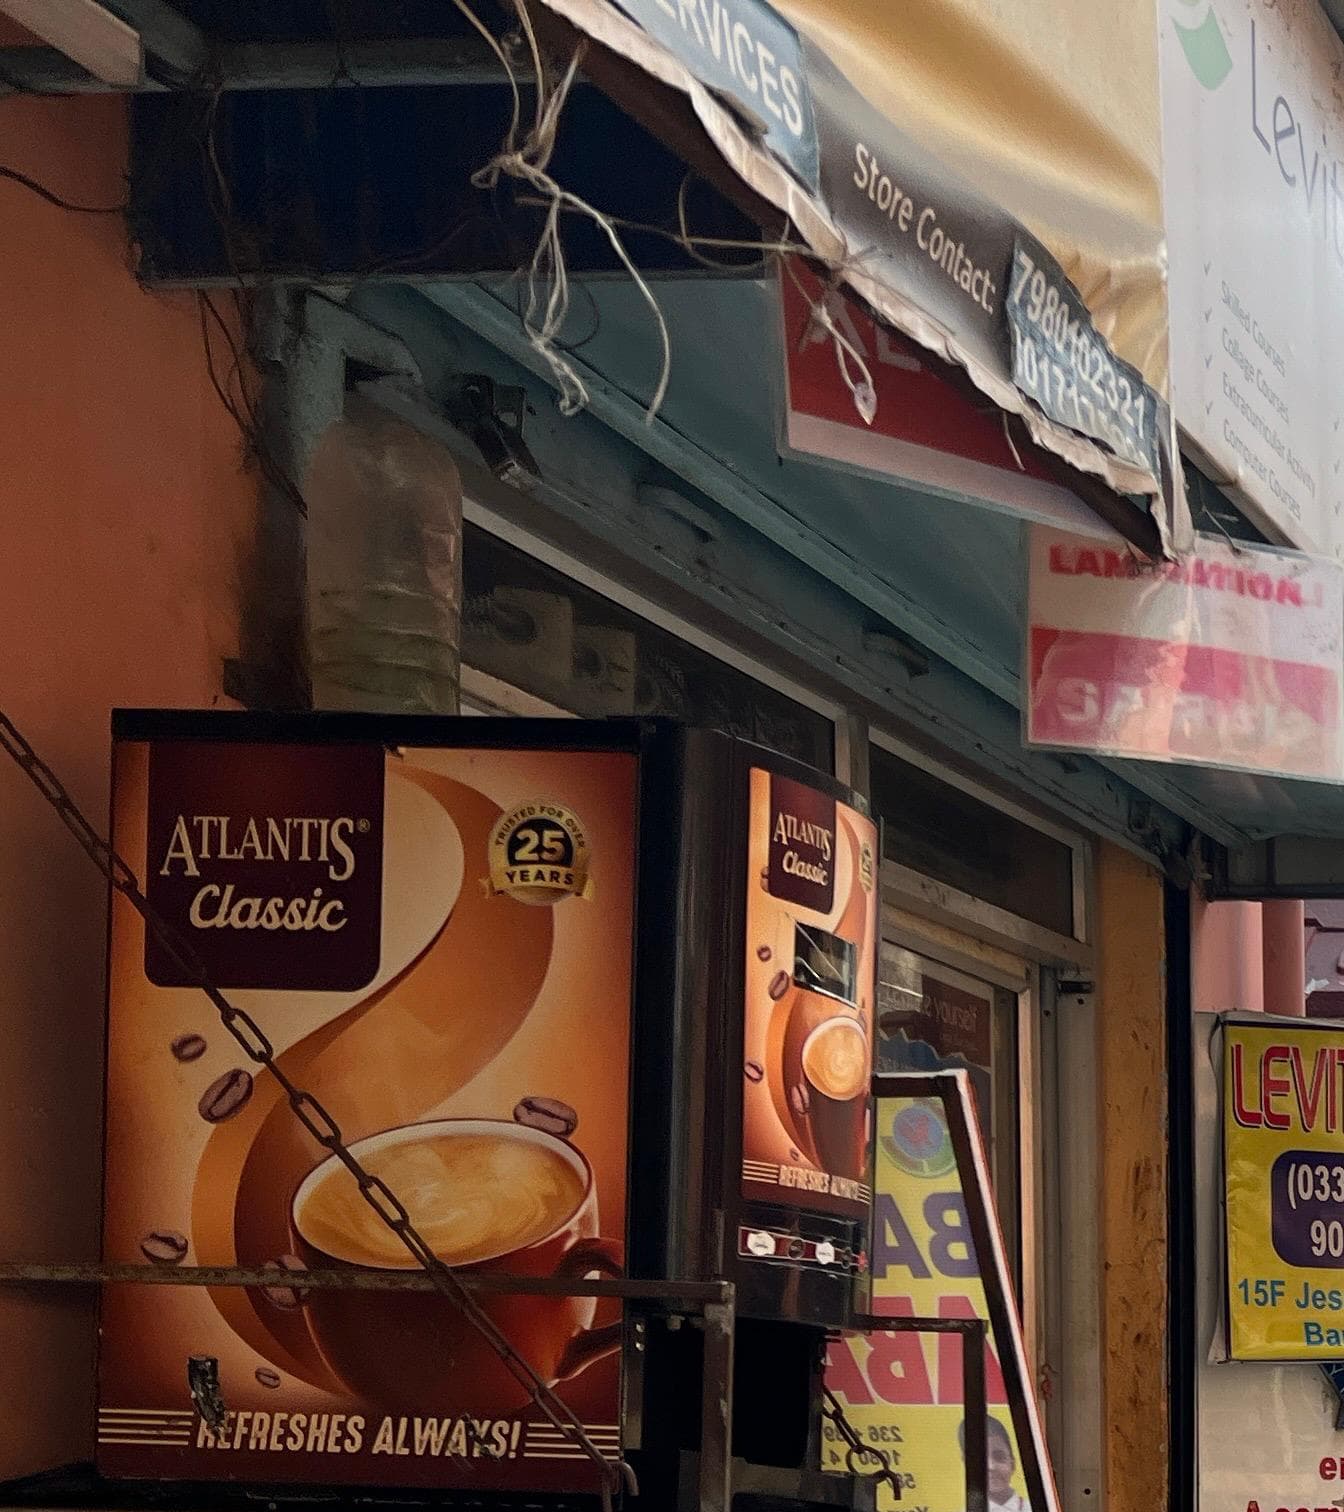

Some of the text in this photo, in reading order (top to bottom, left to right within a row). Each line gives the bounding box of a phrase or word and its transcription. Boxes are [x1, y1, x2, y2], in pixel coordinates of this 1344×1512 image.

[853, 141, 913, 231] Store
[914, 207, 996, 313] Contact:
[1014, 247, 1145, 441] 7980102321
[539, 805, 564, 818] FOR
[514, 829, 566, 861] 25
[773, 811, 832, 861] ATLANTIS
[505, 869, 575, 885] YEARS
[783, 850, 829, 886] Classic
[189, 884, 350, 934] Classic
[1236, 1278, 1286, 1310] 15F
[373, 1415, 521, 1459] ALWAYS!
